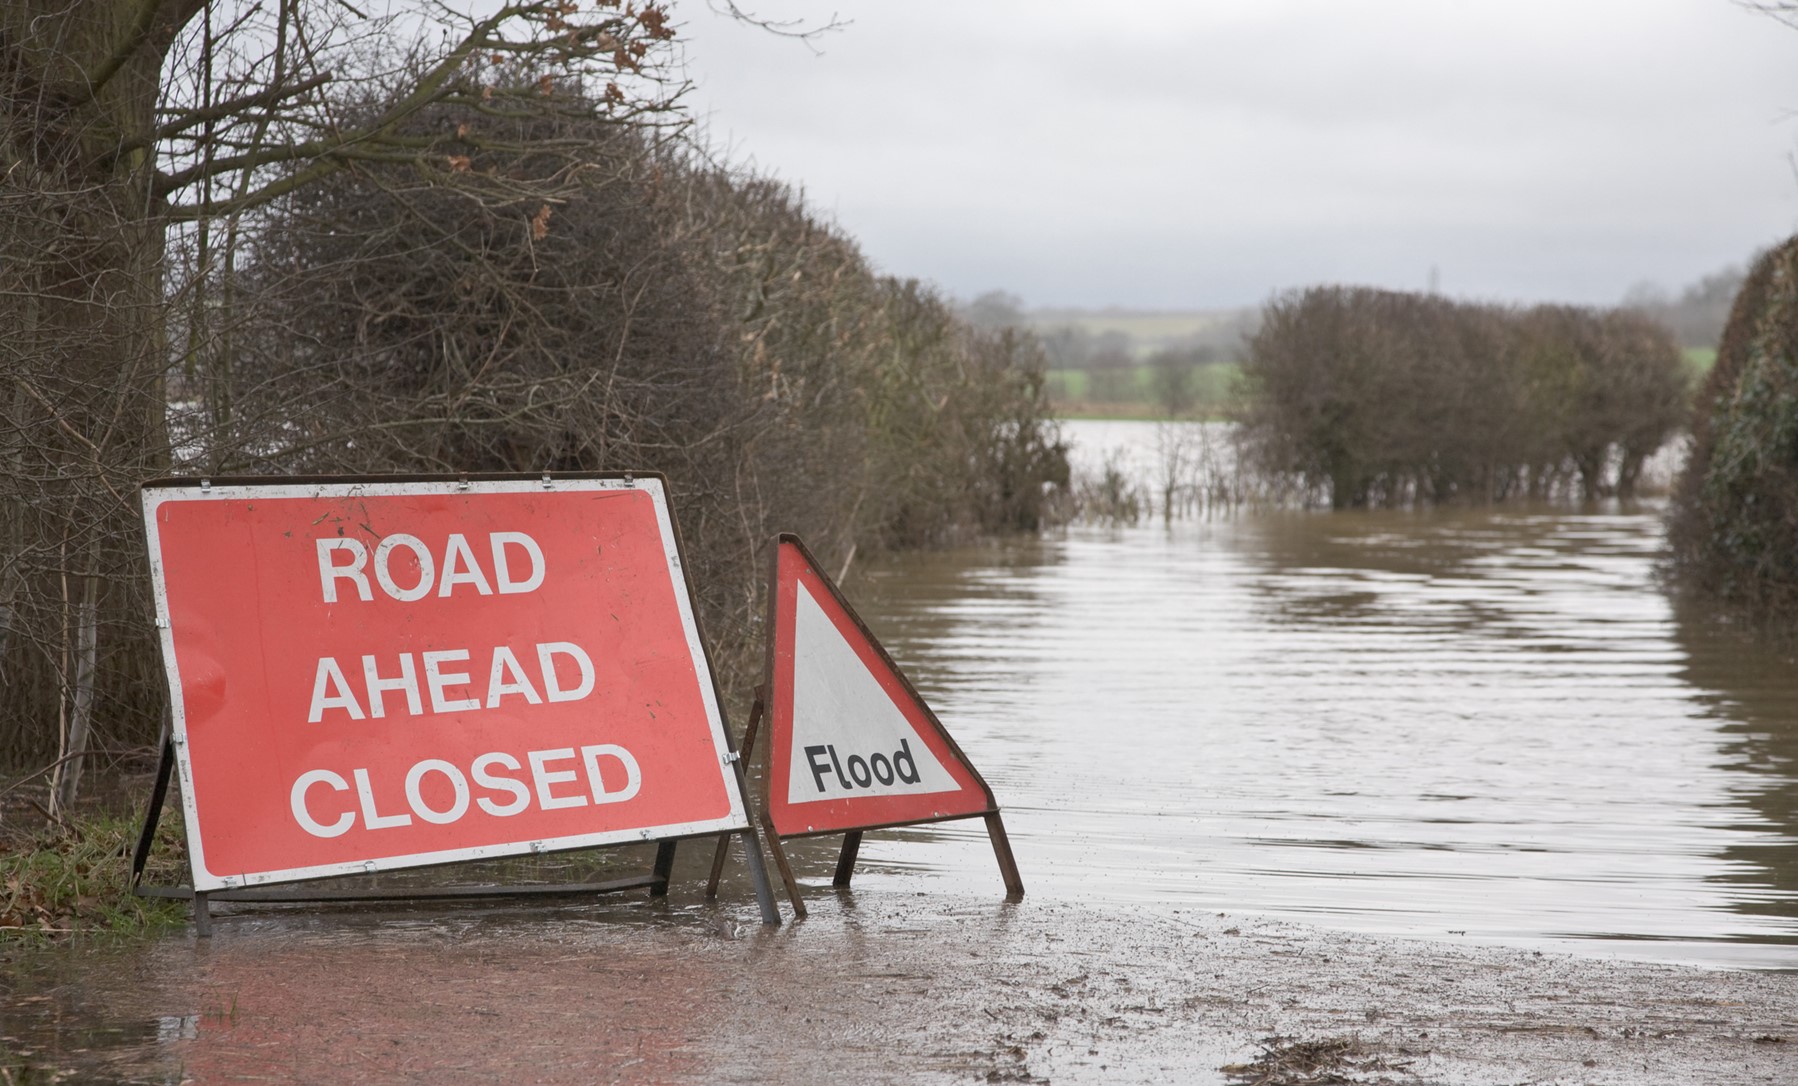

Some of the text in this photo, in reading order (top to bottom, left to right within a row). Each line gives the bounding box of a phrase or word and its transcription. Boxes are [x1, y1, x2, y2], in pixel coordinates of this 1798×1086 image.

[316, 532, 545, 603] ROAD
[308, 642, 595, 723] AHEAD
[291, 744, 641, 838] CLOSED
[804, 739, 921, 792] Flood
